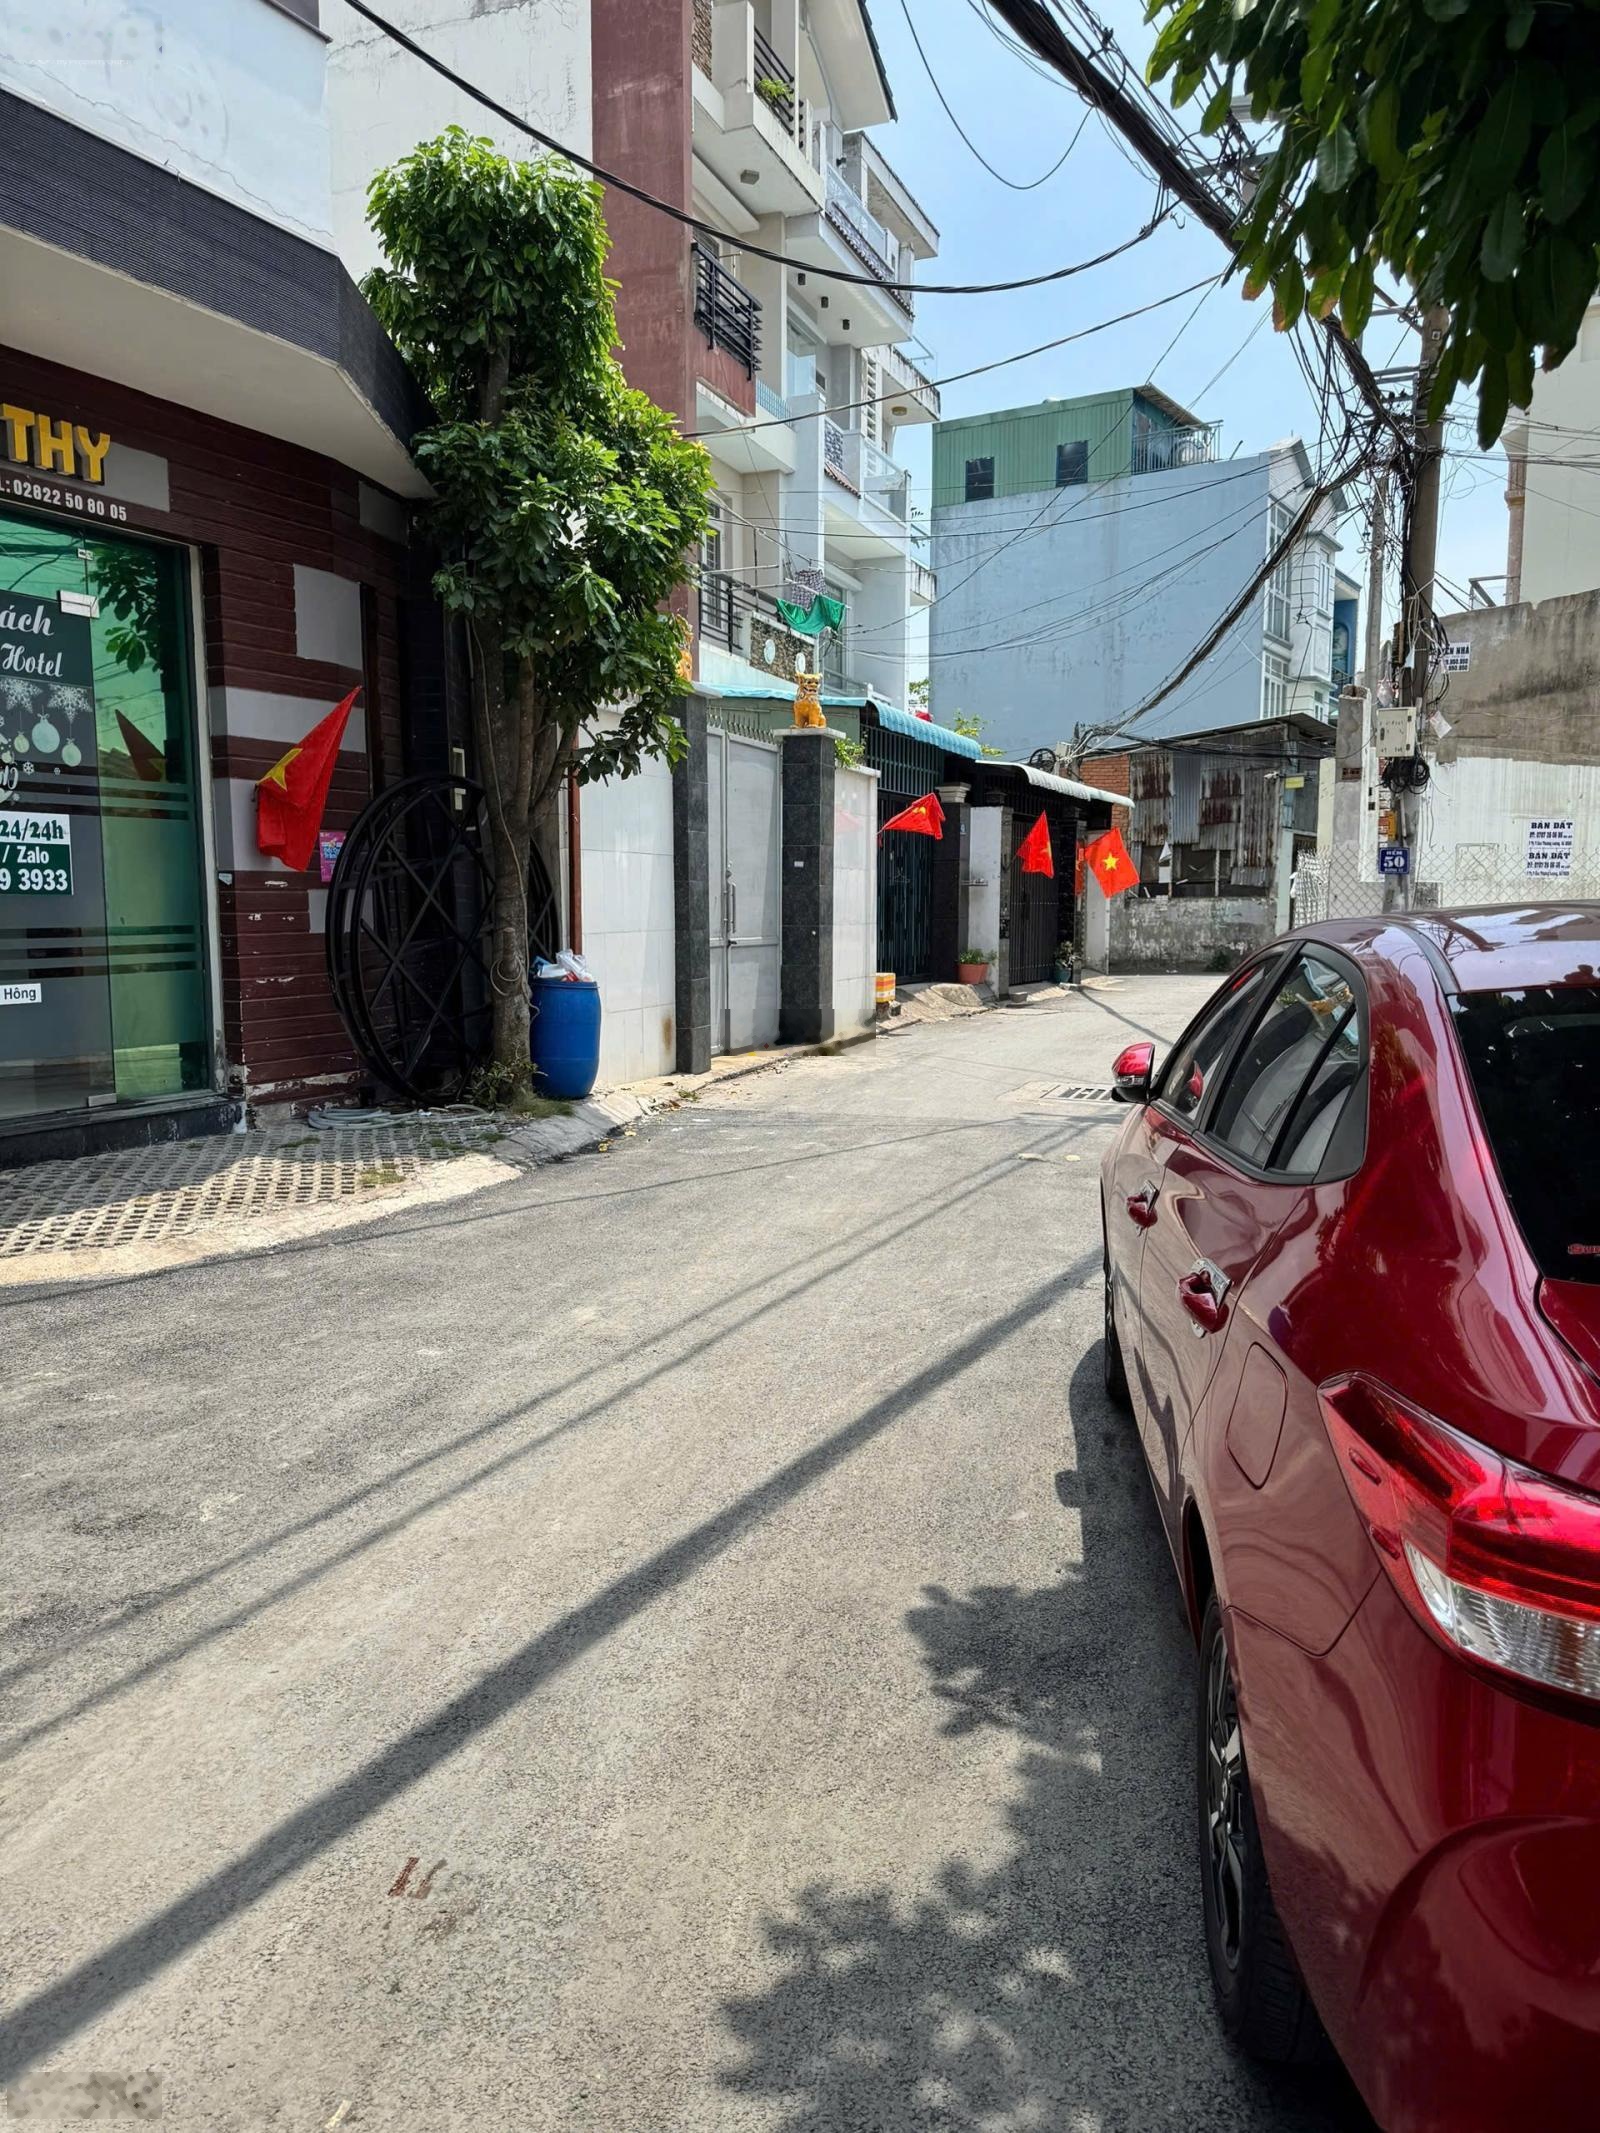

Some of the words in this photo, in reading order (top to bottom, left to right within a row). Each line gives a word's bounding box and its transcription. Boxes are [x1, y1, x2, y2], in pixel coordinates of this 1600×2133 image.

[0, 403, 110, 482] THY
[14, 479, 61, 505] 02822
[65, 489, 83, 510] 50
[87, 498, 105, 516] 80
[110, 504, 127, 521] 05
[0, 604, 55, 636] ách
[1, 642, 63, 678] Hotel
[0, 818, 64, 841] 24/24h
[17, 846, 50, 864] Zalo
[1383, 856, 1405, 868] 50
[18, 868, 68, 891] 3933
[4, 987, 36, 1001] Hông
